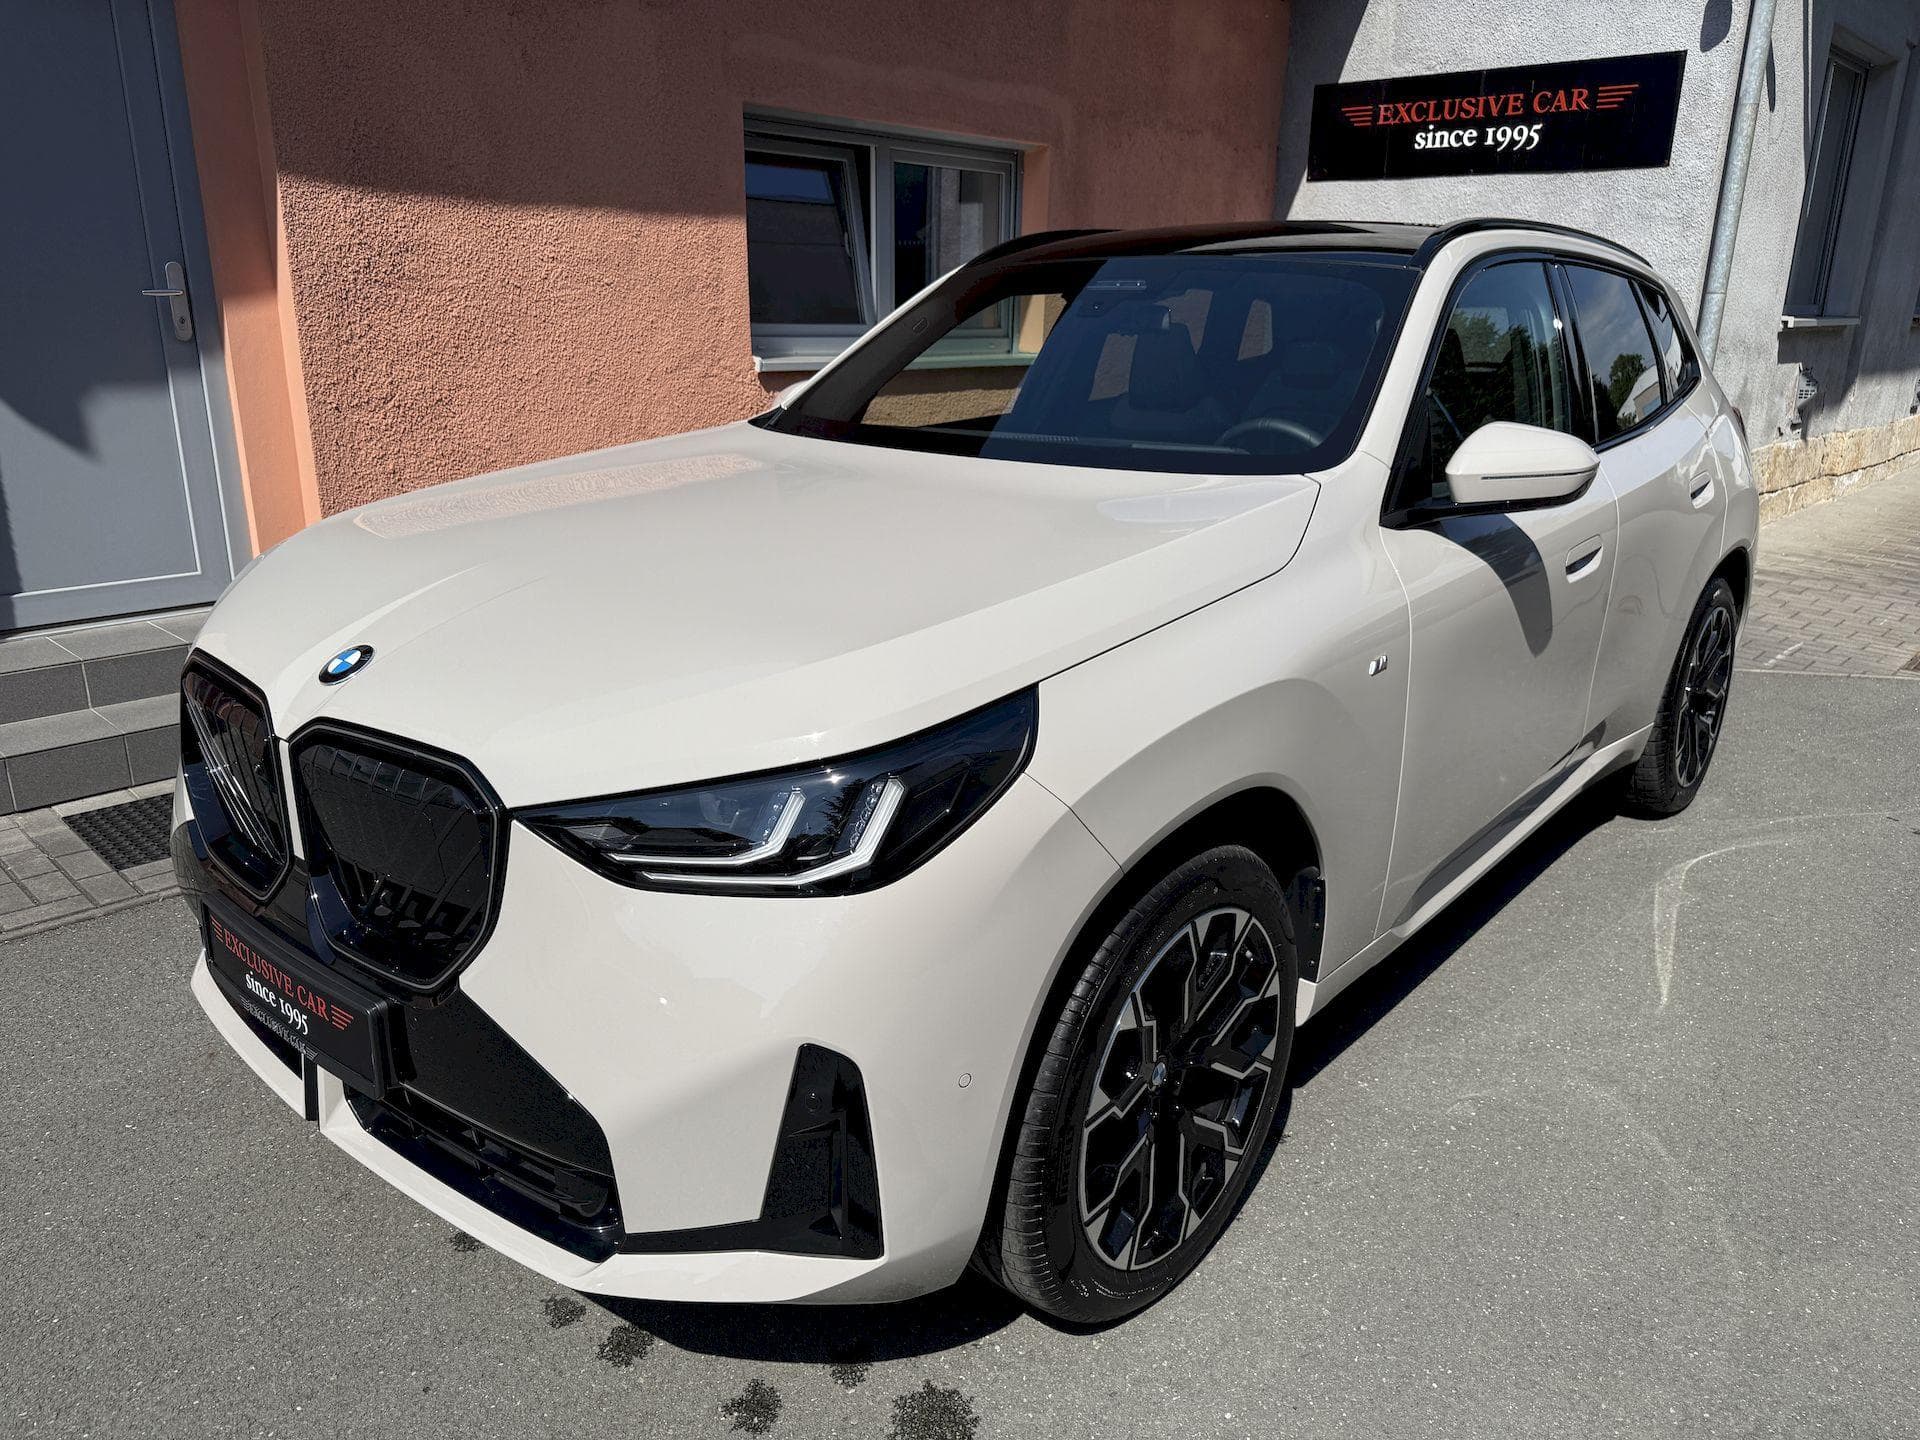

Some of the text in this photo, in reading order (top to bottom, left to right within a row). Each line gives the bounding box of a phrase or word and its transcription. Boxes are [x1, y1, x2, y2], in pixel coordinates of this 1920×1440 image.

[1377, 88, 1590, 126] EXCLUSIVE CAR
[1414, 123, 1544, 152] since 1995
[223, 928, 330, 1021] EXCLUSIVE CAR
[245, 971, 309, 1035] since 1995
